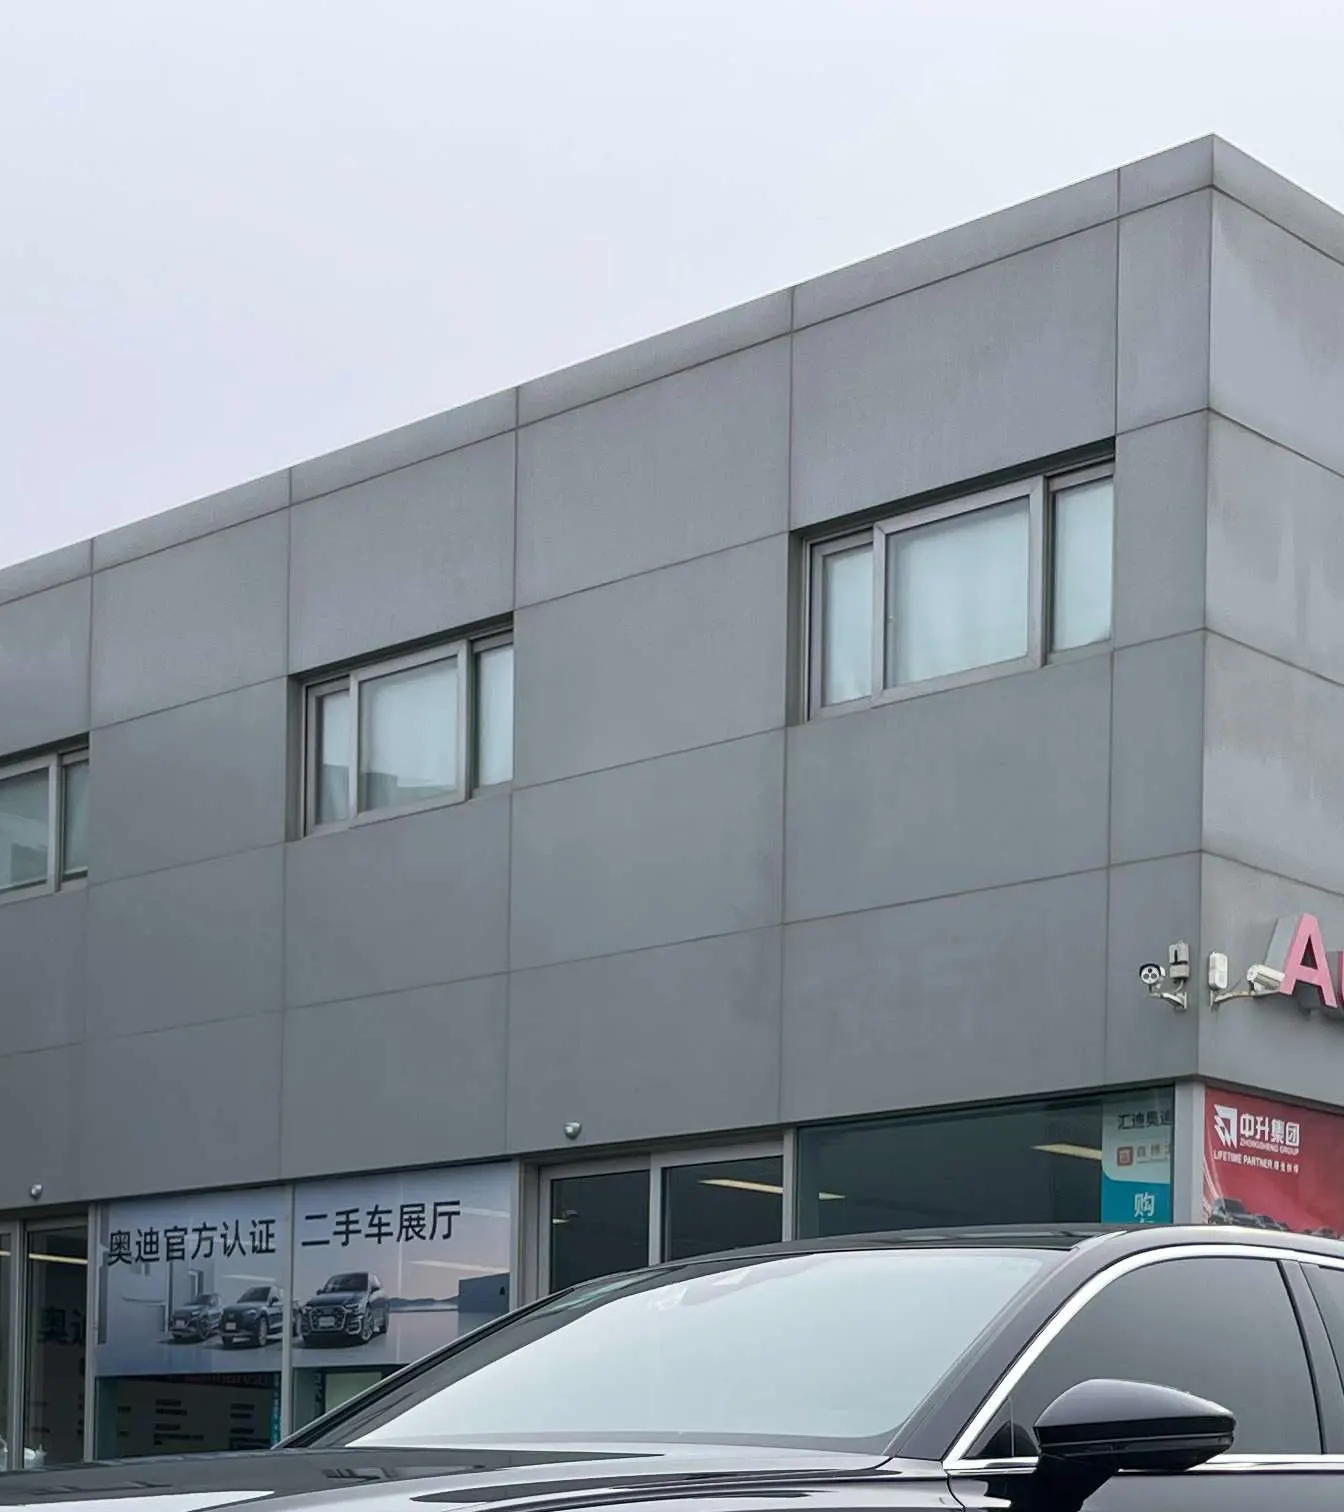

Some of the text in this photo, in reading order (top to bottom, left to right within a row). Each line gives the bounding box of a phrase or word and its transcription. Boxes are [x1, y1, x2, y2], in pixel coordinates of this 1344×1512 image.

[1239, 1113, 1300, 1147] 中升集团
[1134, 1192, 1155, 1224] 购
[107, 1200, 462, 1267] 奥迪官方认证 二手车展厅
